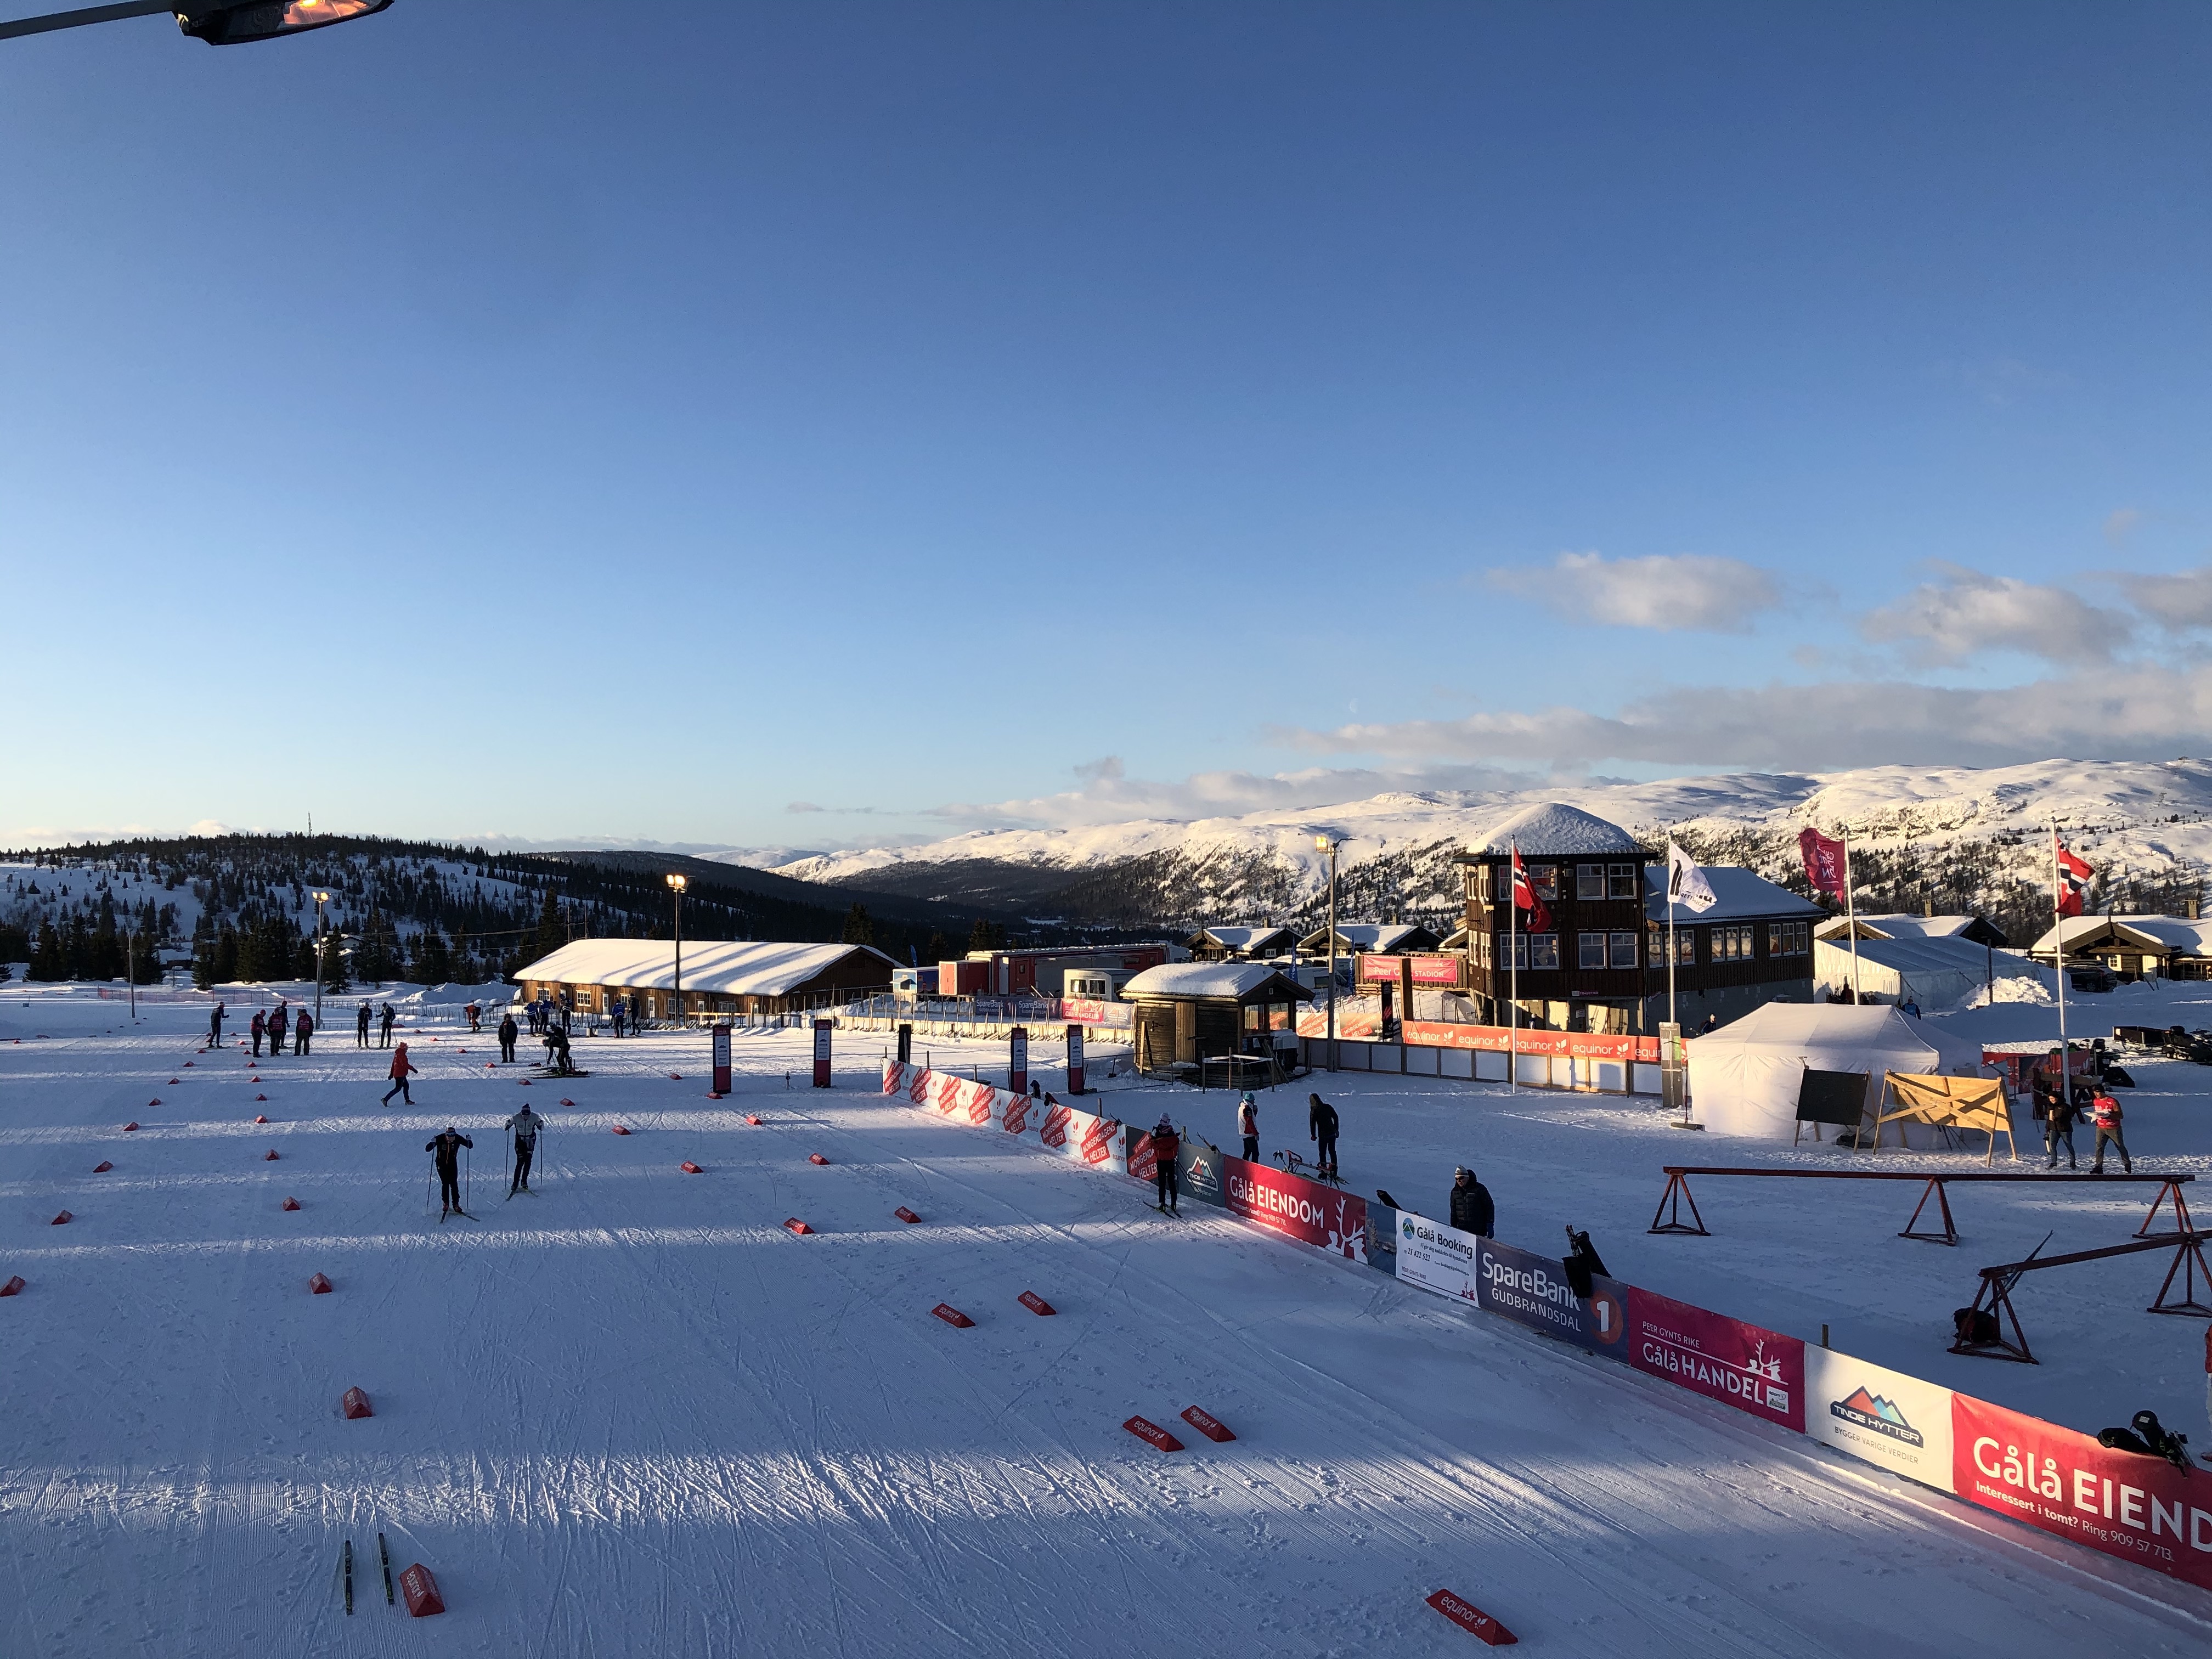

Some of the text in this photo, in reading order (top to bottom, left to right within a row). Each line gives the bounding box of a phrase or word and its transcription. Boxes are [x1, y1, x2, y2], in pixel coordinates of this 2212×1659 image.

[1374, 967, 1391, 975] Peer
[977, 999, 1003, 1008] SpareBank
[1019, 1000, 1048, 1009] SpareBank
[1306, 1026, 1323, 1036] HELTER
[1352, 1027, 1369, 1037] HELTER
[1407, 1030, 1440, 1042] equinor
[1458, 1035, 1495, 1046] equinor
[1516, 1039, 1553, 1050] equinor
[1572, 1044, 1613, 1056] equinor
[1011, 1119, 1024, 1132] HELTER
[1042, 1109, 1070, 1139] MORGENDAGENS
[1049, 1131, 1064, 1146] HELTER
[1082, 1123, 1115, 1153] MORGENDAGENS
[1089, 1146, 1107, 1161] HELTER
[1139, 1163, 1158, 1179] HELTER
[1230, 1175, 1324, 1229] Gålå EIENDOM
[1417, 1227, 1472, 1260] Gålå Booking
[1482, 1252, 1609, 1332] SpareBank 1
[939, 1307, 955, 1318] equinor
[1492, 1288, 1582, 1332] GUDBRANDSDAL
[1643, 1321, 1700, 1348] PEER GYNTS RIKE
[1643, 1342, 1679, 1373] Gålå
[1681, 1355, 1764, 1405] HANDEL
[1190, 1410, 1211, 1427] equinor
[1833, 1404, 1920, 1443] TINDE HYTTER
[1134, 1420, 1158, 1438] equinor
[1835, 1426, 1918, 1465] BYGGER VARIGE VERDIER
[1973, 1436, 2062, 1502] Gålå
[1976, 1480, 2035, 1513] Interessert
[2038, 1503, 2042, 1514] i
[2045, 1506, 2079, 1528] tomt?
[2083, 1520, 2108, 1541] Ring
[2111, 1530, 2134, 1547] 909
[2137, 1538, 2150, 1552] 57
[1441, 1596, 1478, 1622] equinor
